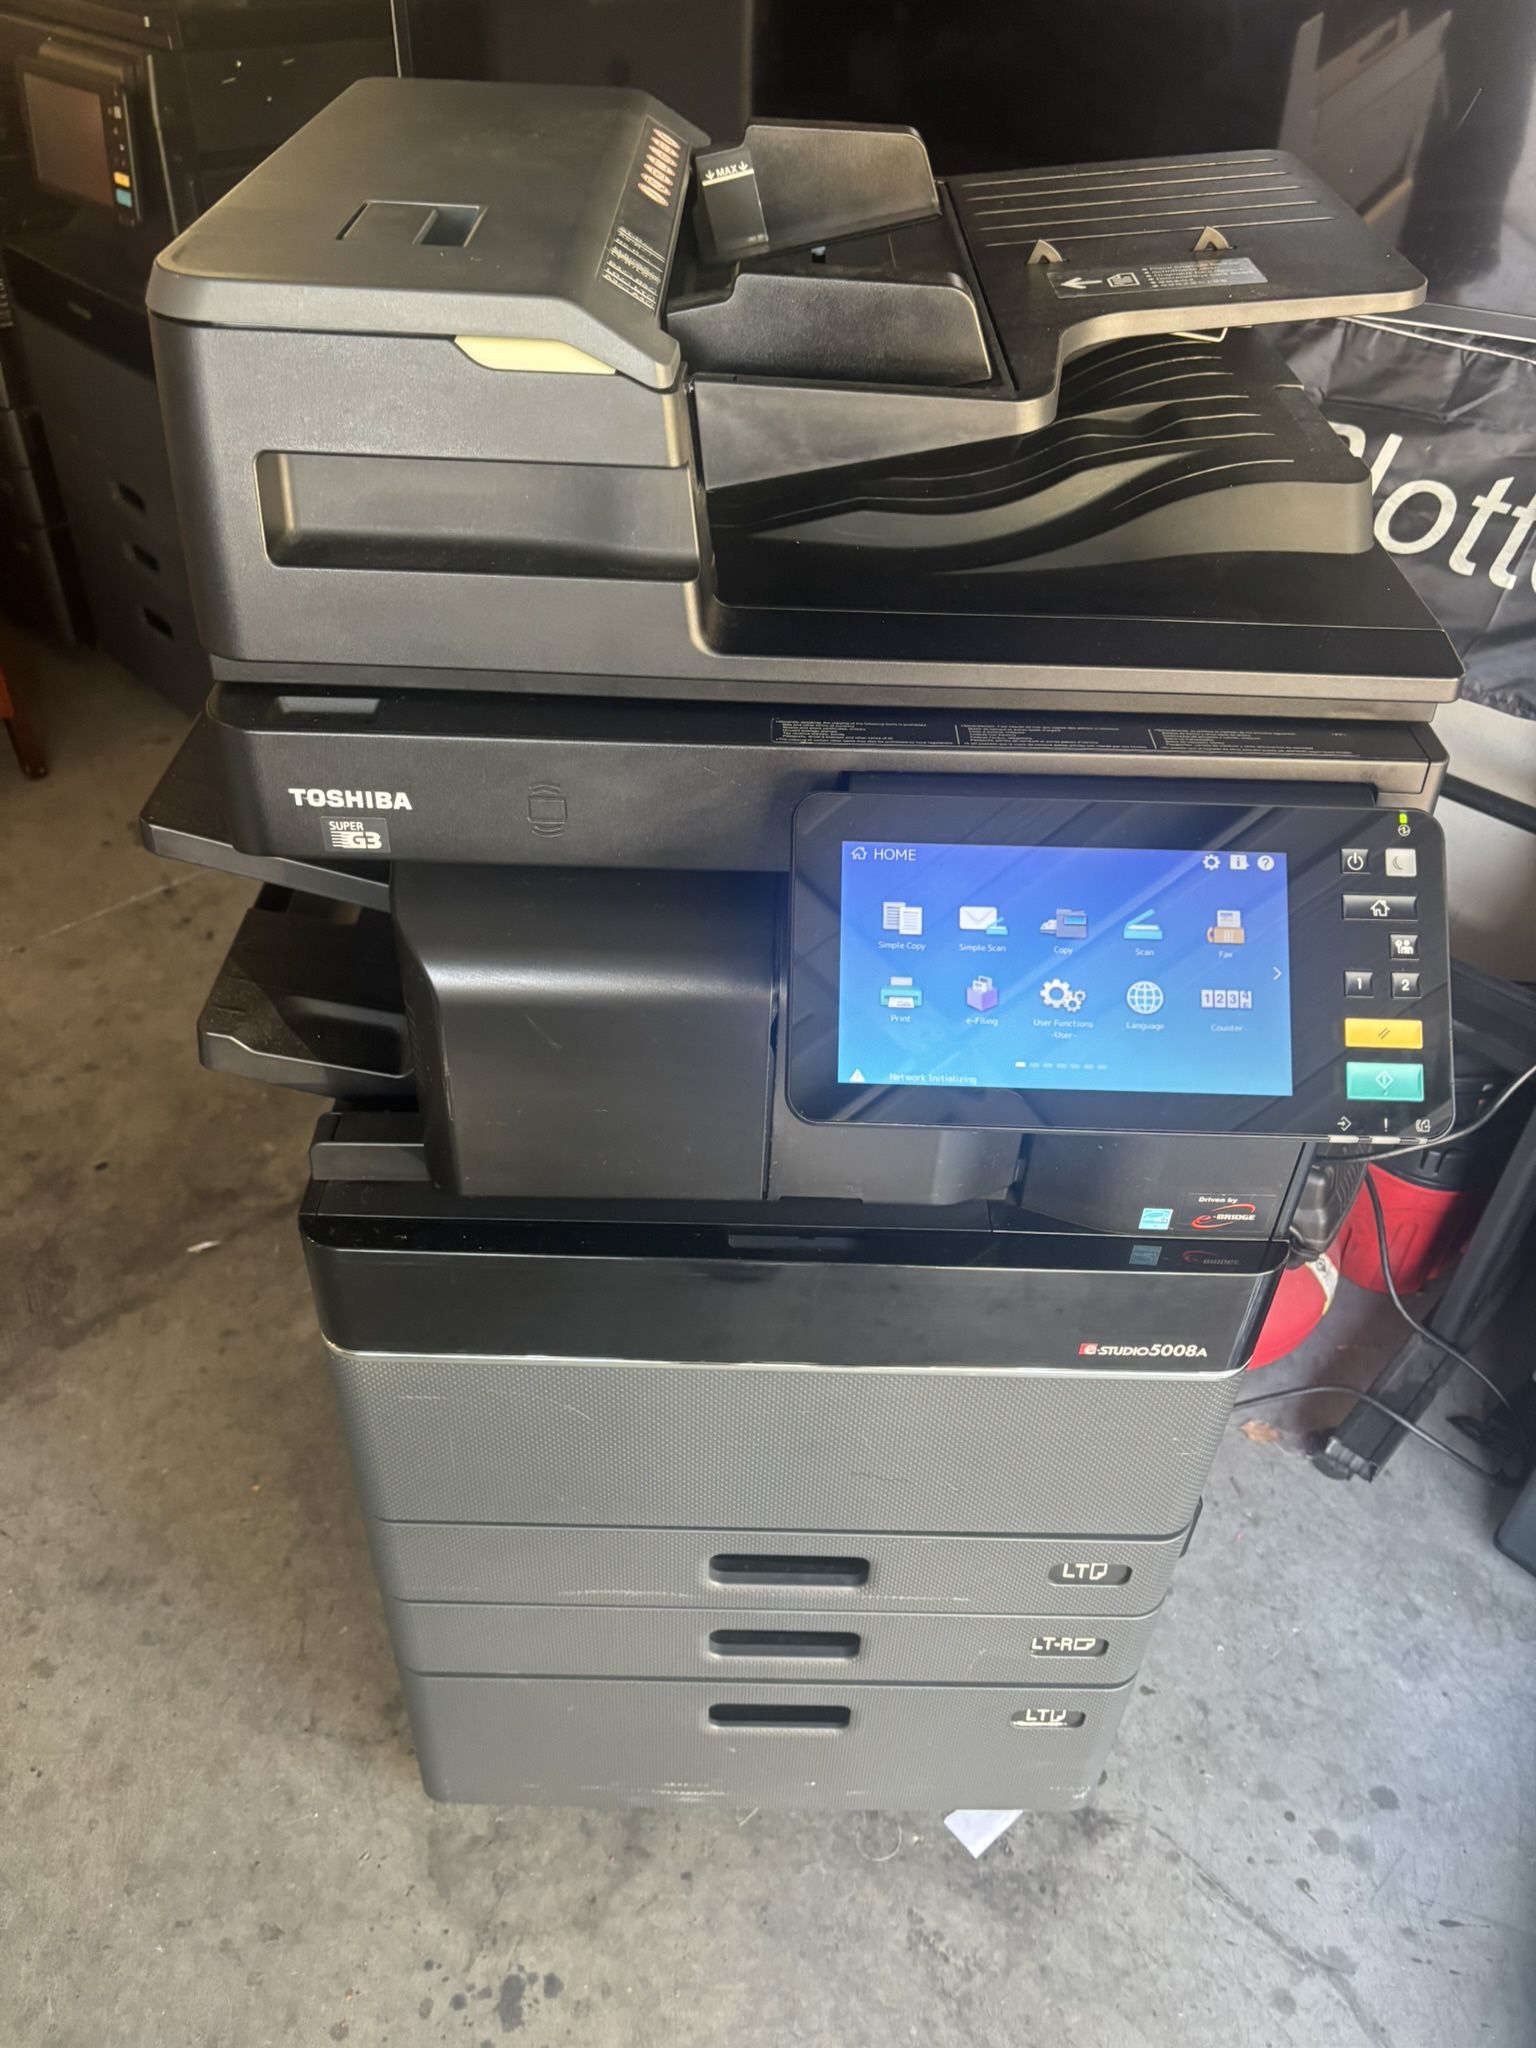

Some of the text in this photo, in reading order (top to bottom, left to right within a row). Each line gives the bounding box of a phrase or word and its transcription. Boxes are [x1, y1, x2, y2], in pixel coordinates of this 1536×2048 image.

[715, 164, 738, 178] MAX
[1328, 421, 1536, 592] lott
[288, 788, 413, 810] TOSHIBA
[328, 820, 364, 831] SUPER
[341, 831, 382, 850] G3
[873, 848, 917, 862] HOME
[878, 941, 926, 951] Simple Copy
[959, 943, 1006, 953] Simple Scan
[1053, 945, 1073, 956] Copy
[1135, 948, 1154, 957] Scan
[1219, 951, 1233, 959] Fax
[1356, 977, 1363, 991] 1
[1402, 979, 1410, 991] 2
[890, 1015, 911, 1023] Print
[966, 1017, 998, 1027] e-Filing
[1033, 1018, 1094, 1029] User Functions
[1126, 1021, 1164, 1031] Language
[1211, 1024, 1243, 1032] Counter
[889, 1073, 977, 1084] Network Initializing
